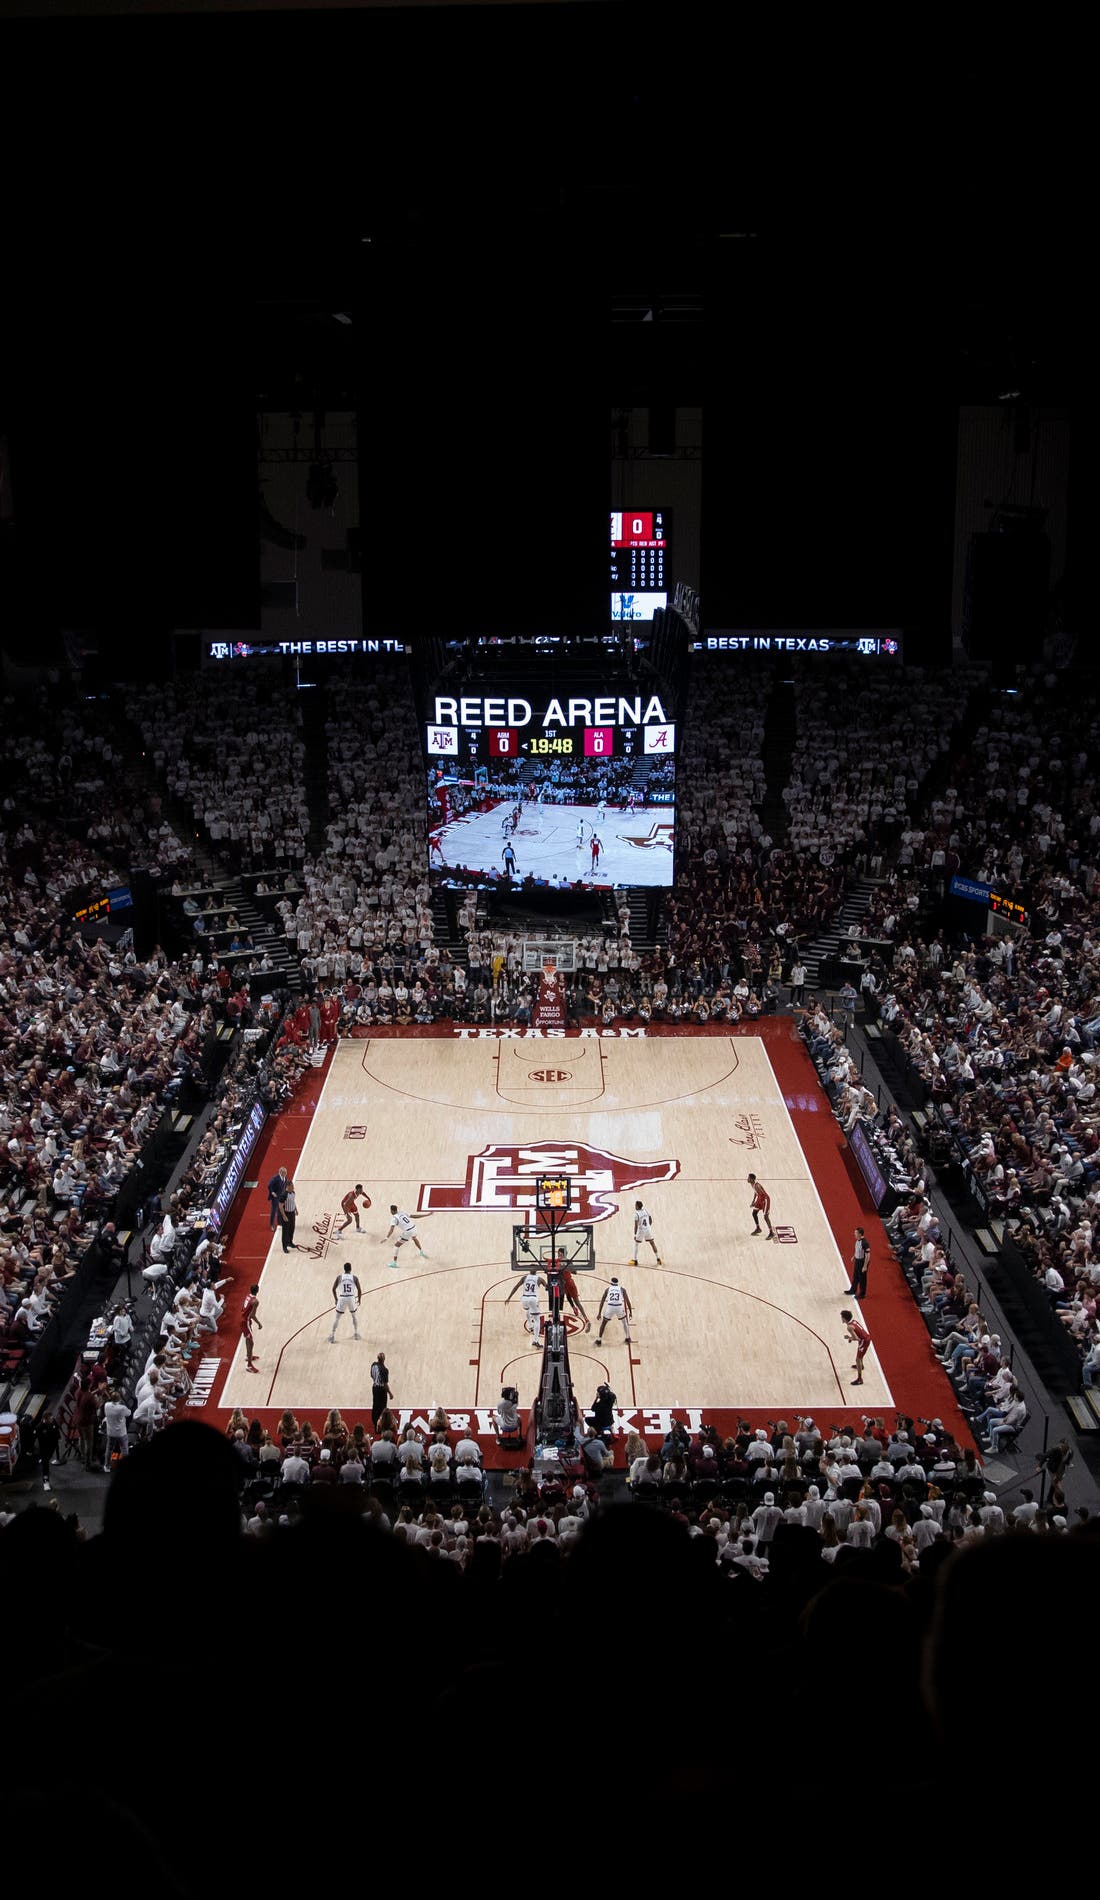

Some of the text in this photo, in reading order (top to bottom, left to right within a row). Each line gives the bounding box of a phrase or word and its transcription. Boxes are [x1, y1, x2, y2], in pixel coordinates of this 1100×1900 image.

[632, 519, 643, 534] 0
[279, 642, 312, 654] THE
[316, 641, 357, 653] BEST
[362, 640, 379, 652] IN
[707, 638, 750, 650] BEST
[754, 638, 770, 650] IN
[775, 638, 830, 651] TEXAS
[435, 696, 667, 726] REED ARENA
[545, 730, 557, 738] 1ST
[499, 739, 509, 752] 0
[530, 739, 573, 753] 19:48
[594, 739, 604, 752] 0
[453, 1028, 648, 1038] TEXAS A&M
[532, 1070, 568, 1082] SEC
[217, 1184, 231, 1212] THE
[225, 1160, 240, 1193] BEST
[234, 1148, 244, 1170] IN
[239, 1124, 255, 1158] TEXAS
[343, 1283, 352, 1293] 15
[524, 1283, 536, 1293] 34
[609, 1292, 620, 1301] 23
